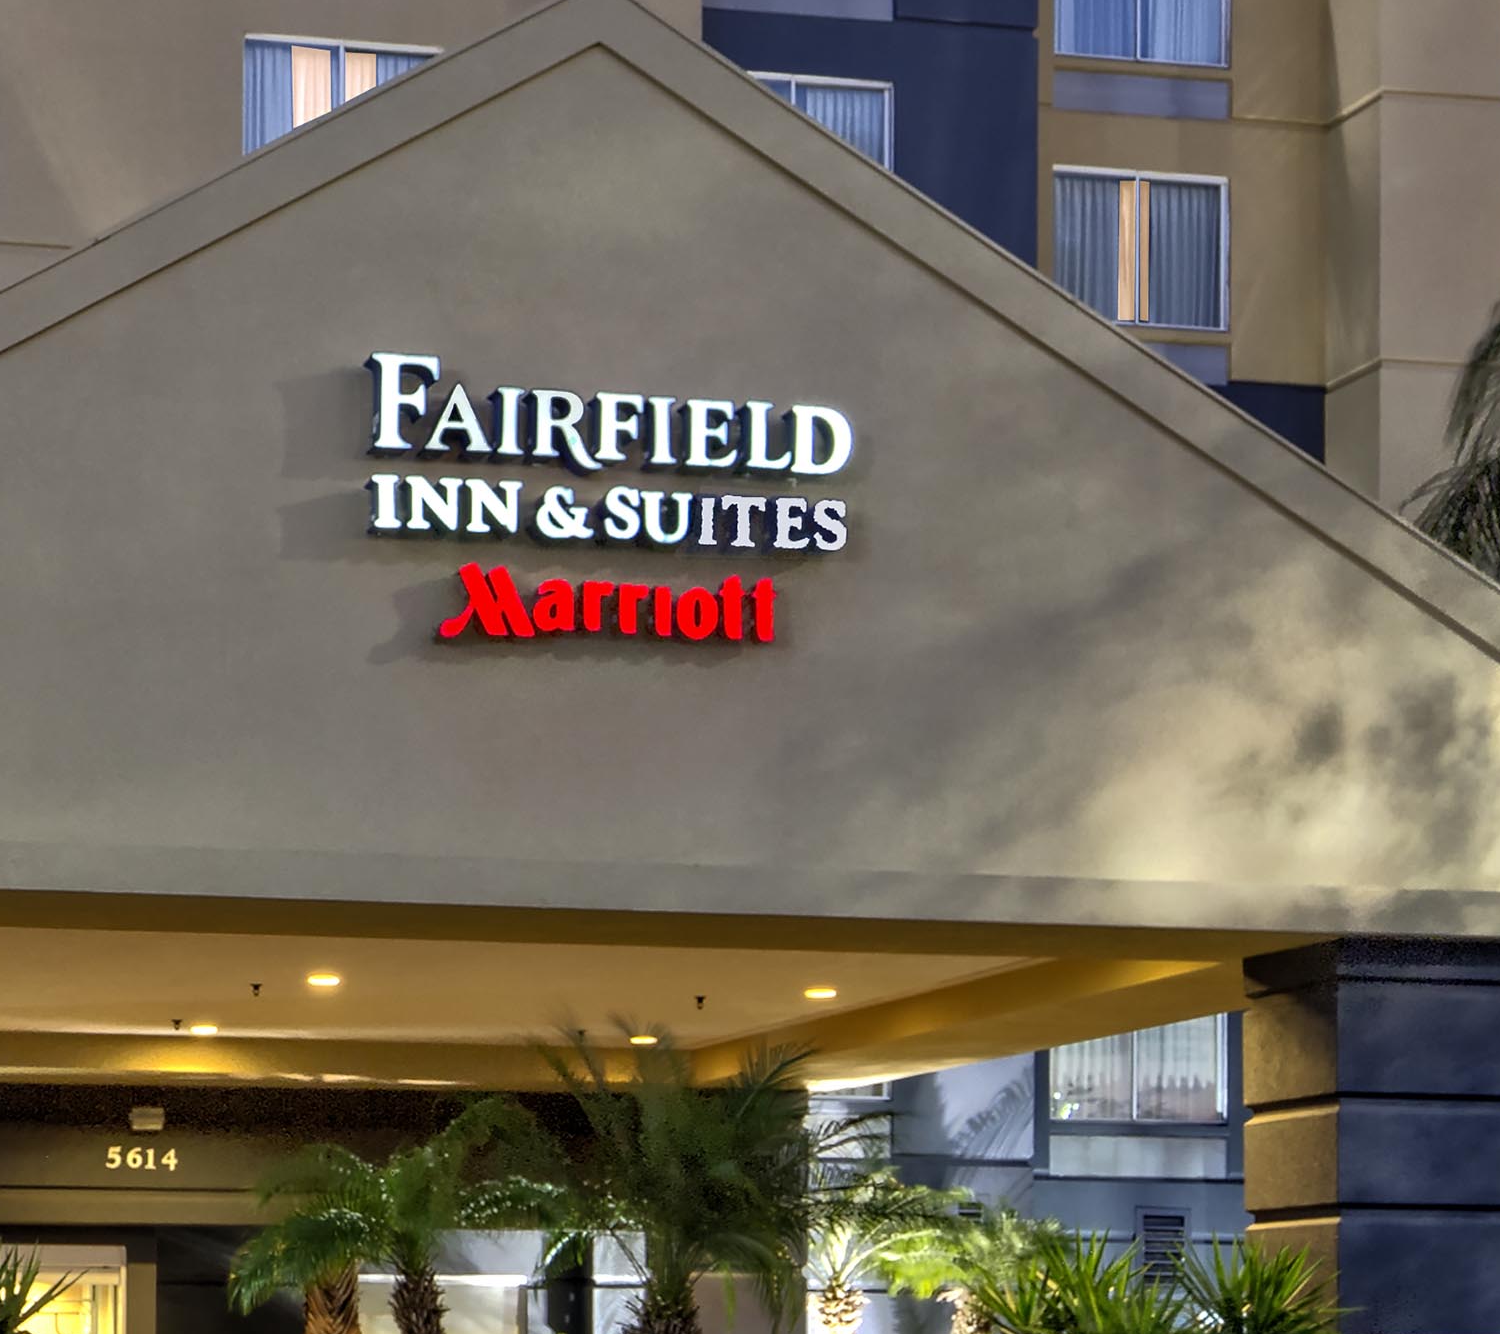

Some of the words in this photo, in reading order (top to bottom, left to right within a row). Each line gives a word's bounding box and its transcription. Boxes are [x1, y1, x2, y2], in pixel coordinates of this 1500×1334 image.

[369, 351, 854, 475] FAIRFIELD
[370, 473, 523, 534] INN
[535, 486, 594, 540] &
[602, 486, 849, 552] SUITES
[439, 562, 777, 643] Marriott
[105, 1145, 179, 1172] 5614
